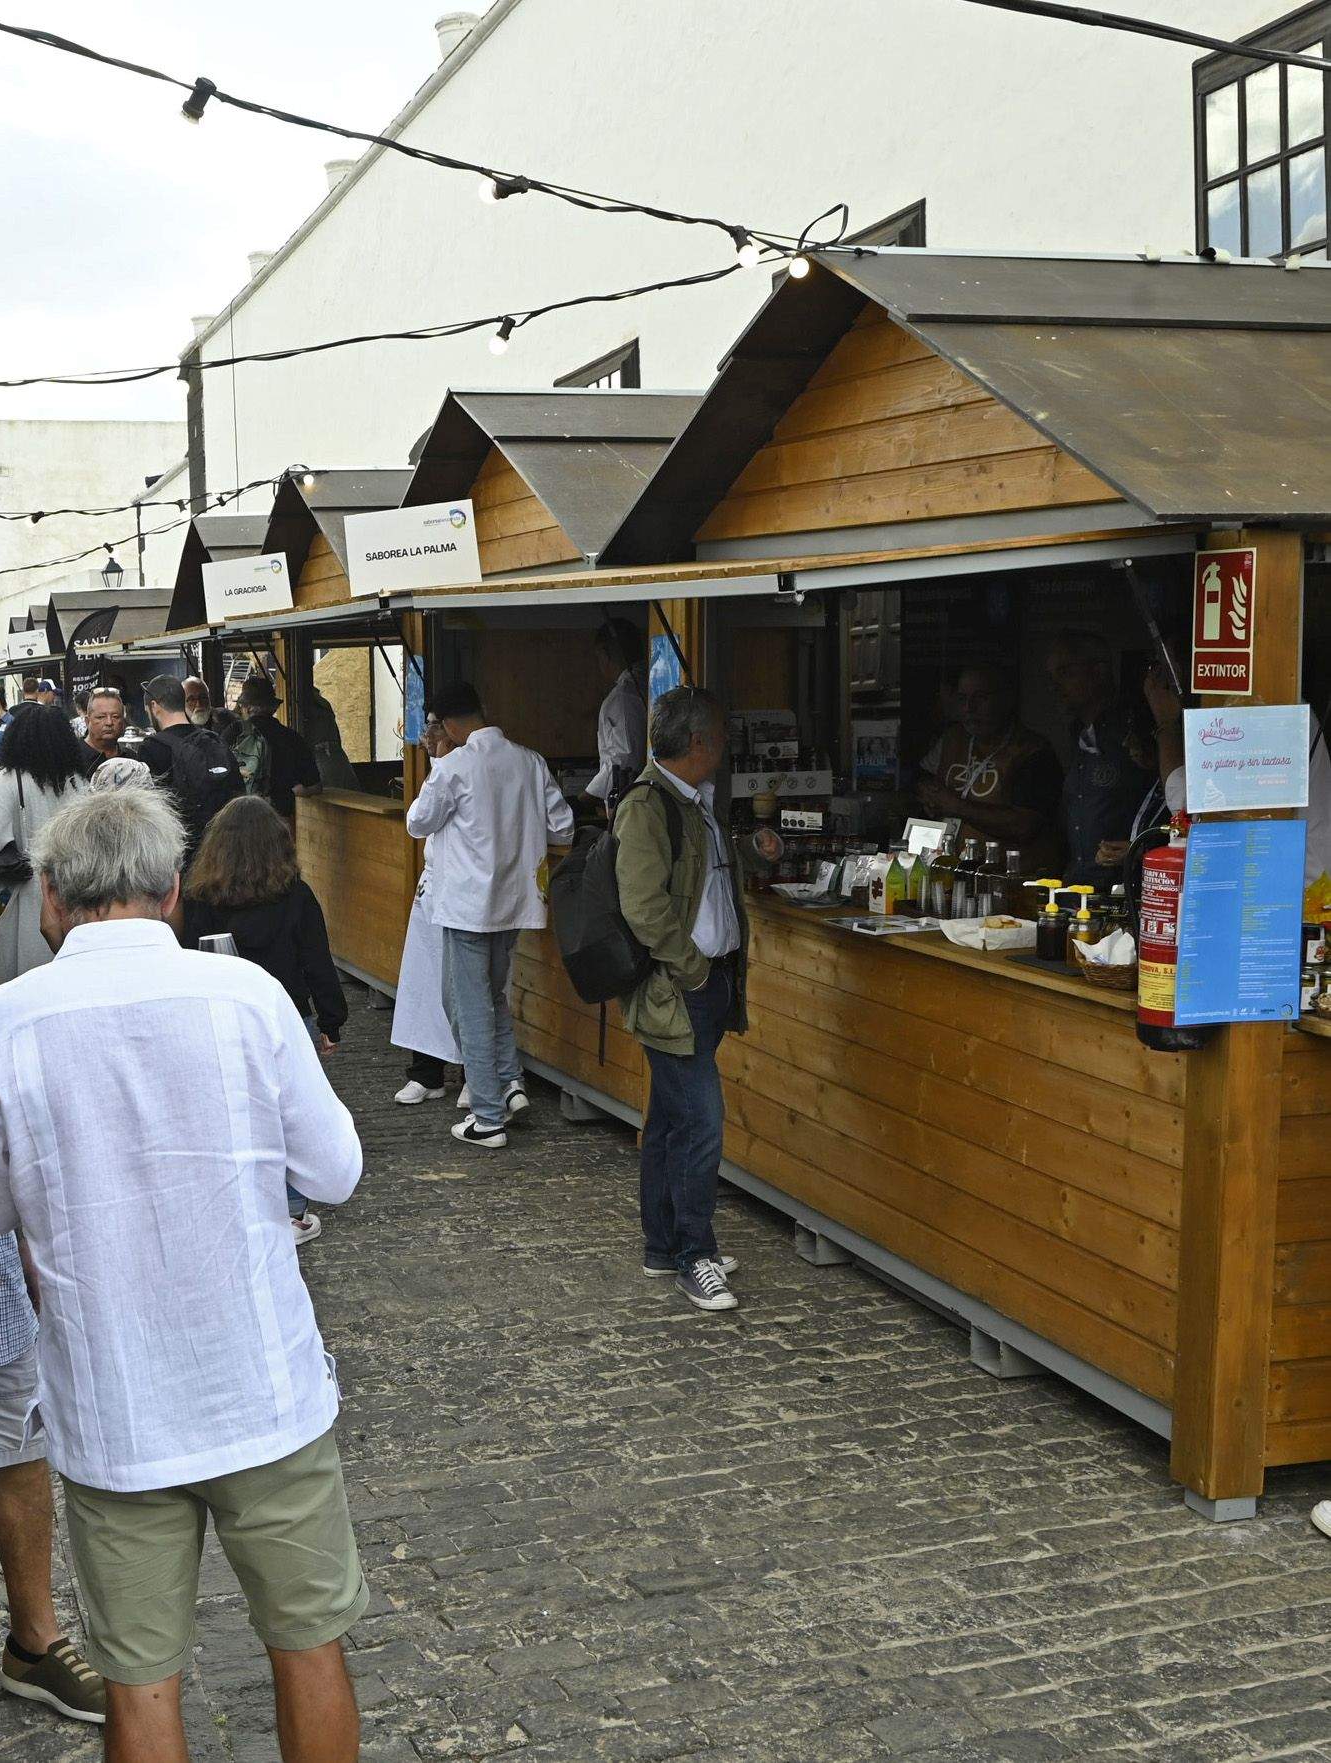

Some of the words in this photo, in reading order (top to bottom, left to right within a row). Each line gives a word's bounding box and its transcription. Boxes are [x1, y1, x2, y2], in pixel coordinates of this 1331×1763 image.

[365, 548, 408, 561] SABOREA
[409, 547, 422, 557] LA
[424, 542, 457, 555] PALMA
[233, 585, 267, 595] GRACIOSA
[1197, 663, 1246, 678] EXTINTOR
[1214, 758, 1238, 772] gluten
[1261, 756, 1291, 766] lactosa
